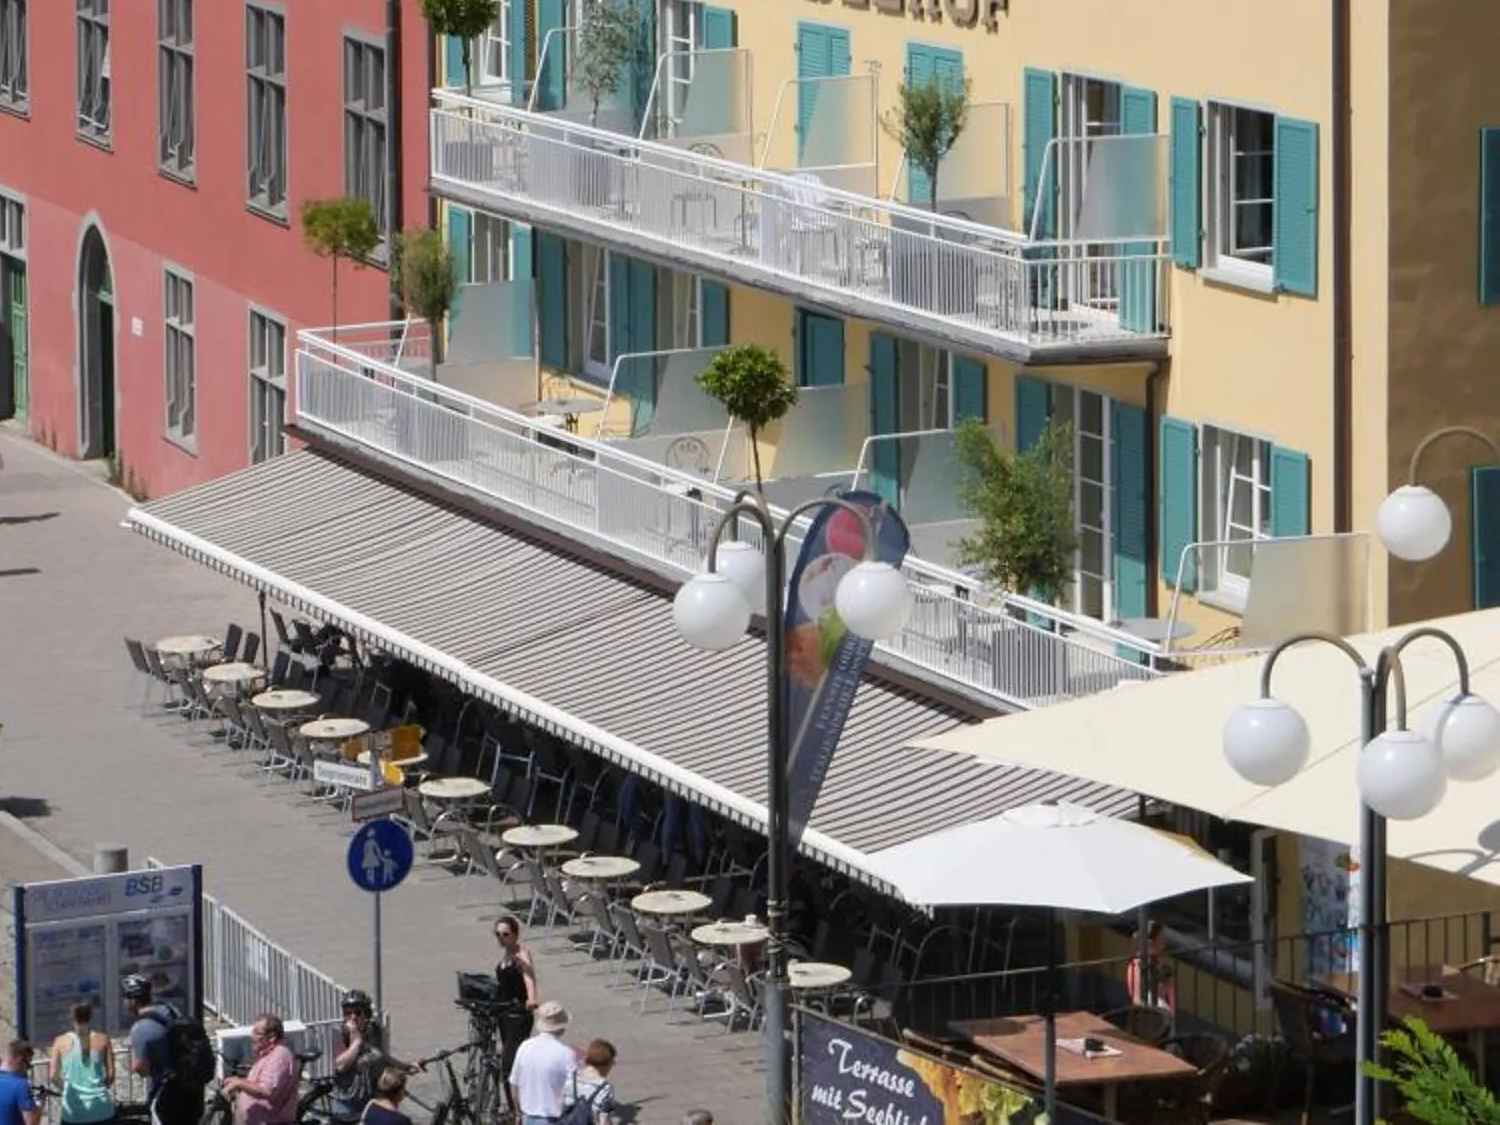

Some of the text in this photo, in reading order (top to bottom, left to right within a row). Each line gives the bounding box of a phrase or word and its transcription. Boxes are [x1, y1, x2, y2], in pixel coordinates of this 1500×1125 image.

[125, 875, 164, 897] BSB
[828, 1038, 914, 1098] Terrasse
[812, 1083, 841, 1110] mit
